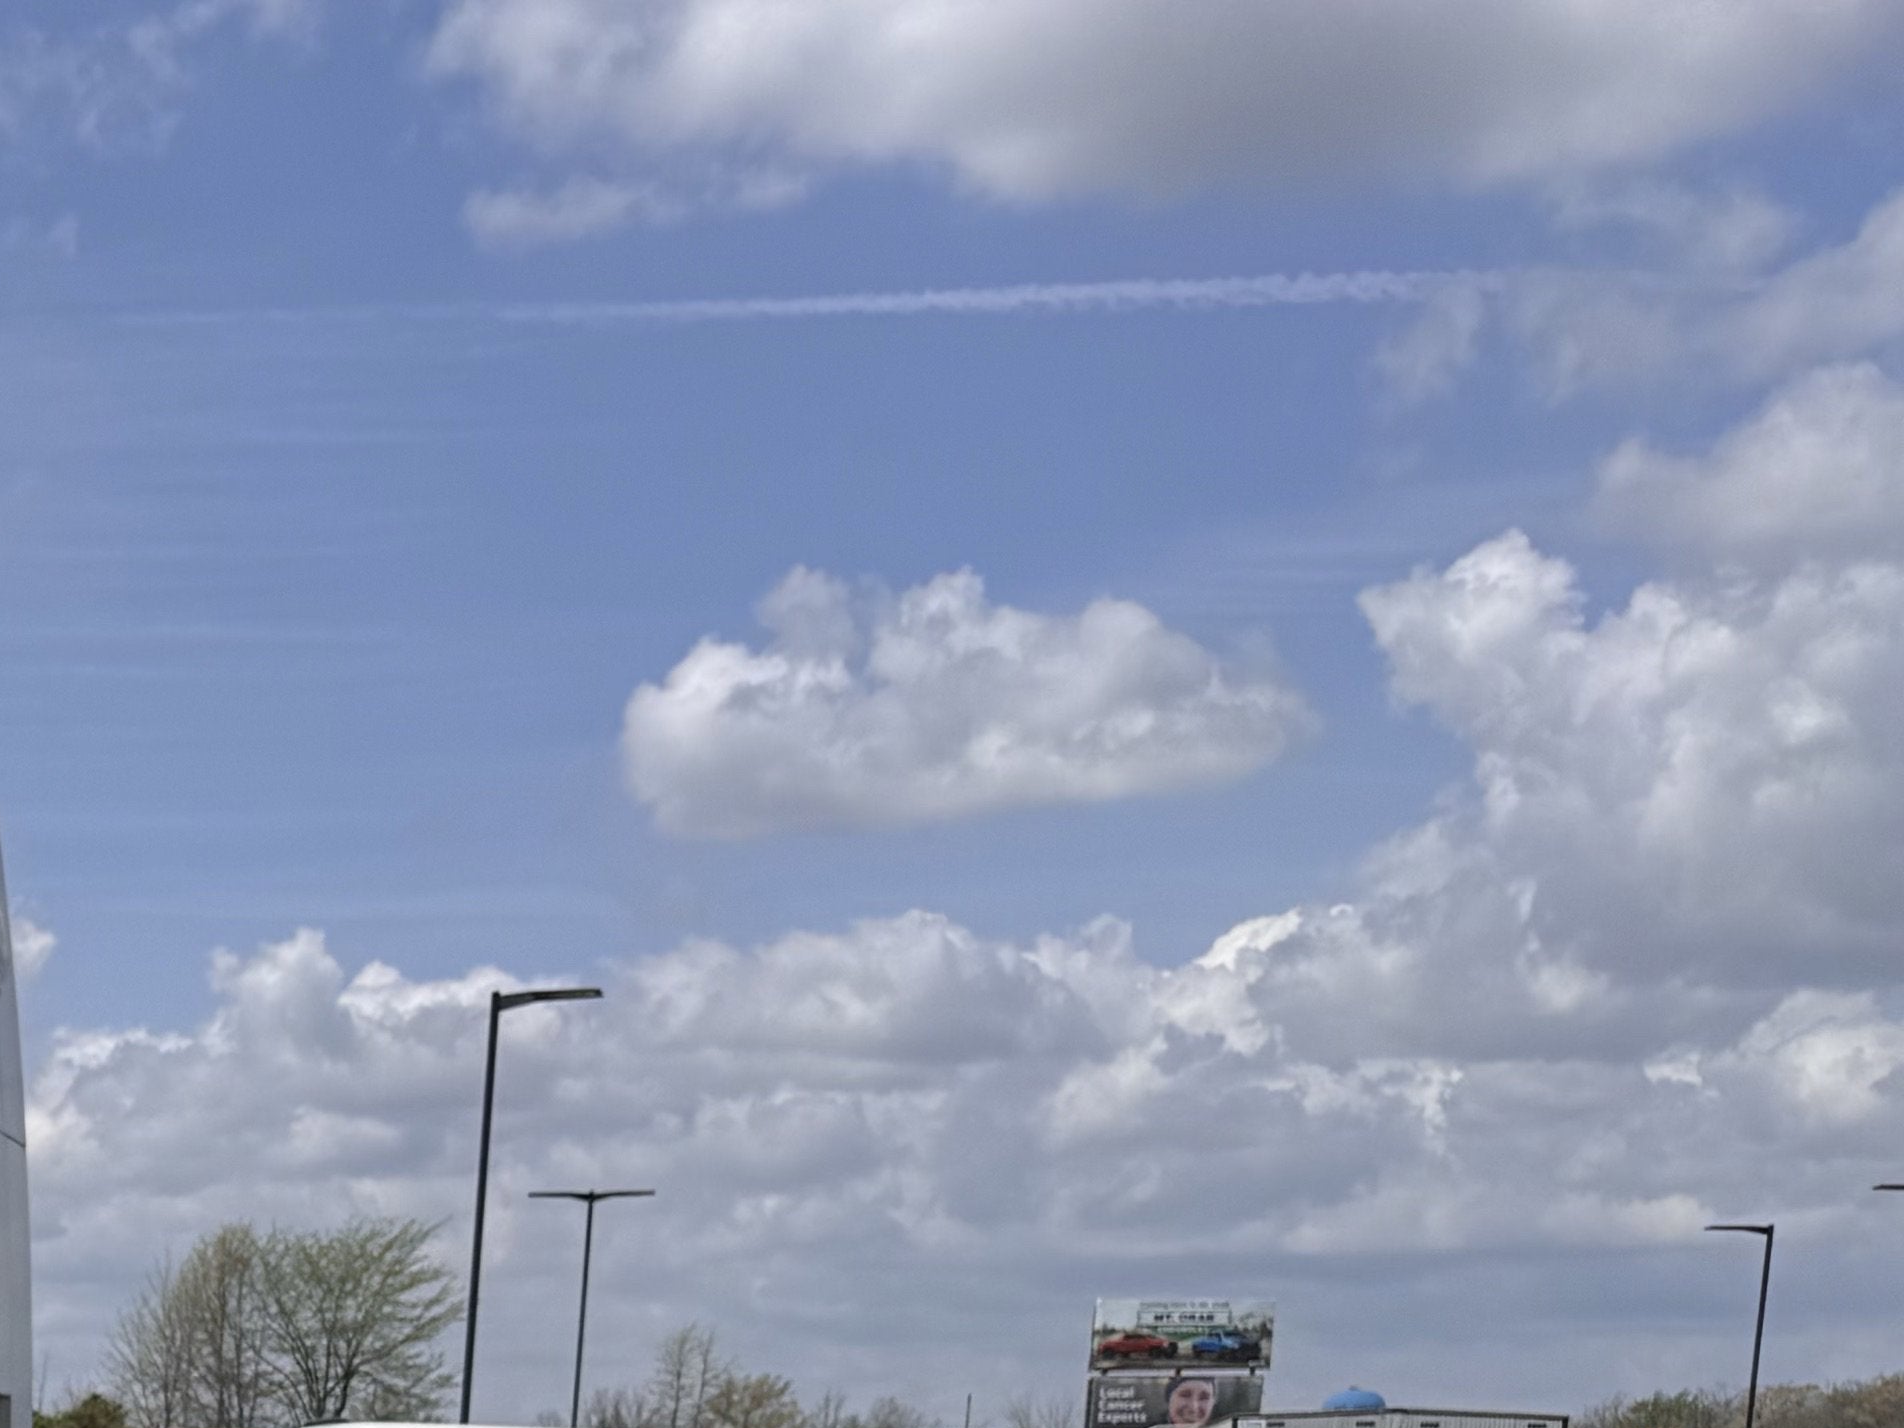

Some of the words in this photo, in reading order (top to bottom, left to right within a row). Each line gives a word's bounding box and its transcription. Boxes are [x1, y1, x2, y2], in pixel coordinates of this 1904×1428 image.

[1099, 1386, 1135, 1399] Local
[1099, 1400, 1145, 1411] Cancer
[1097, 1412, 1148, 1426] Experts
